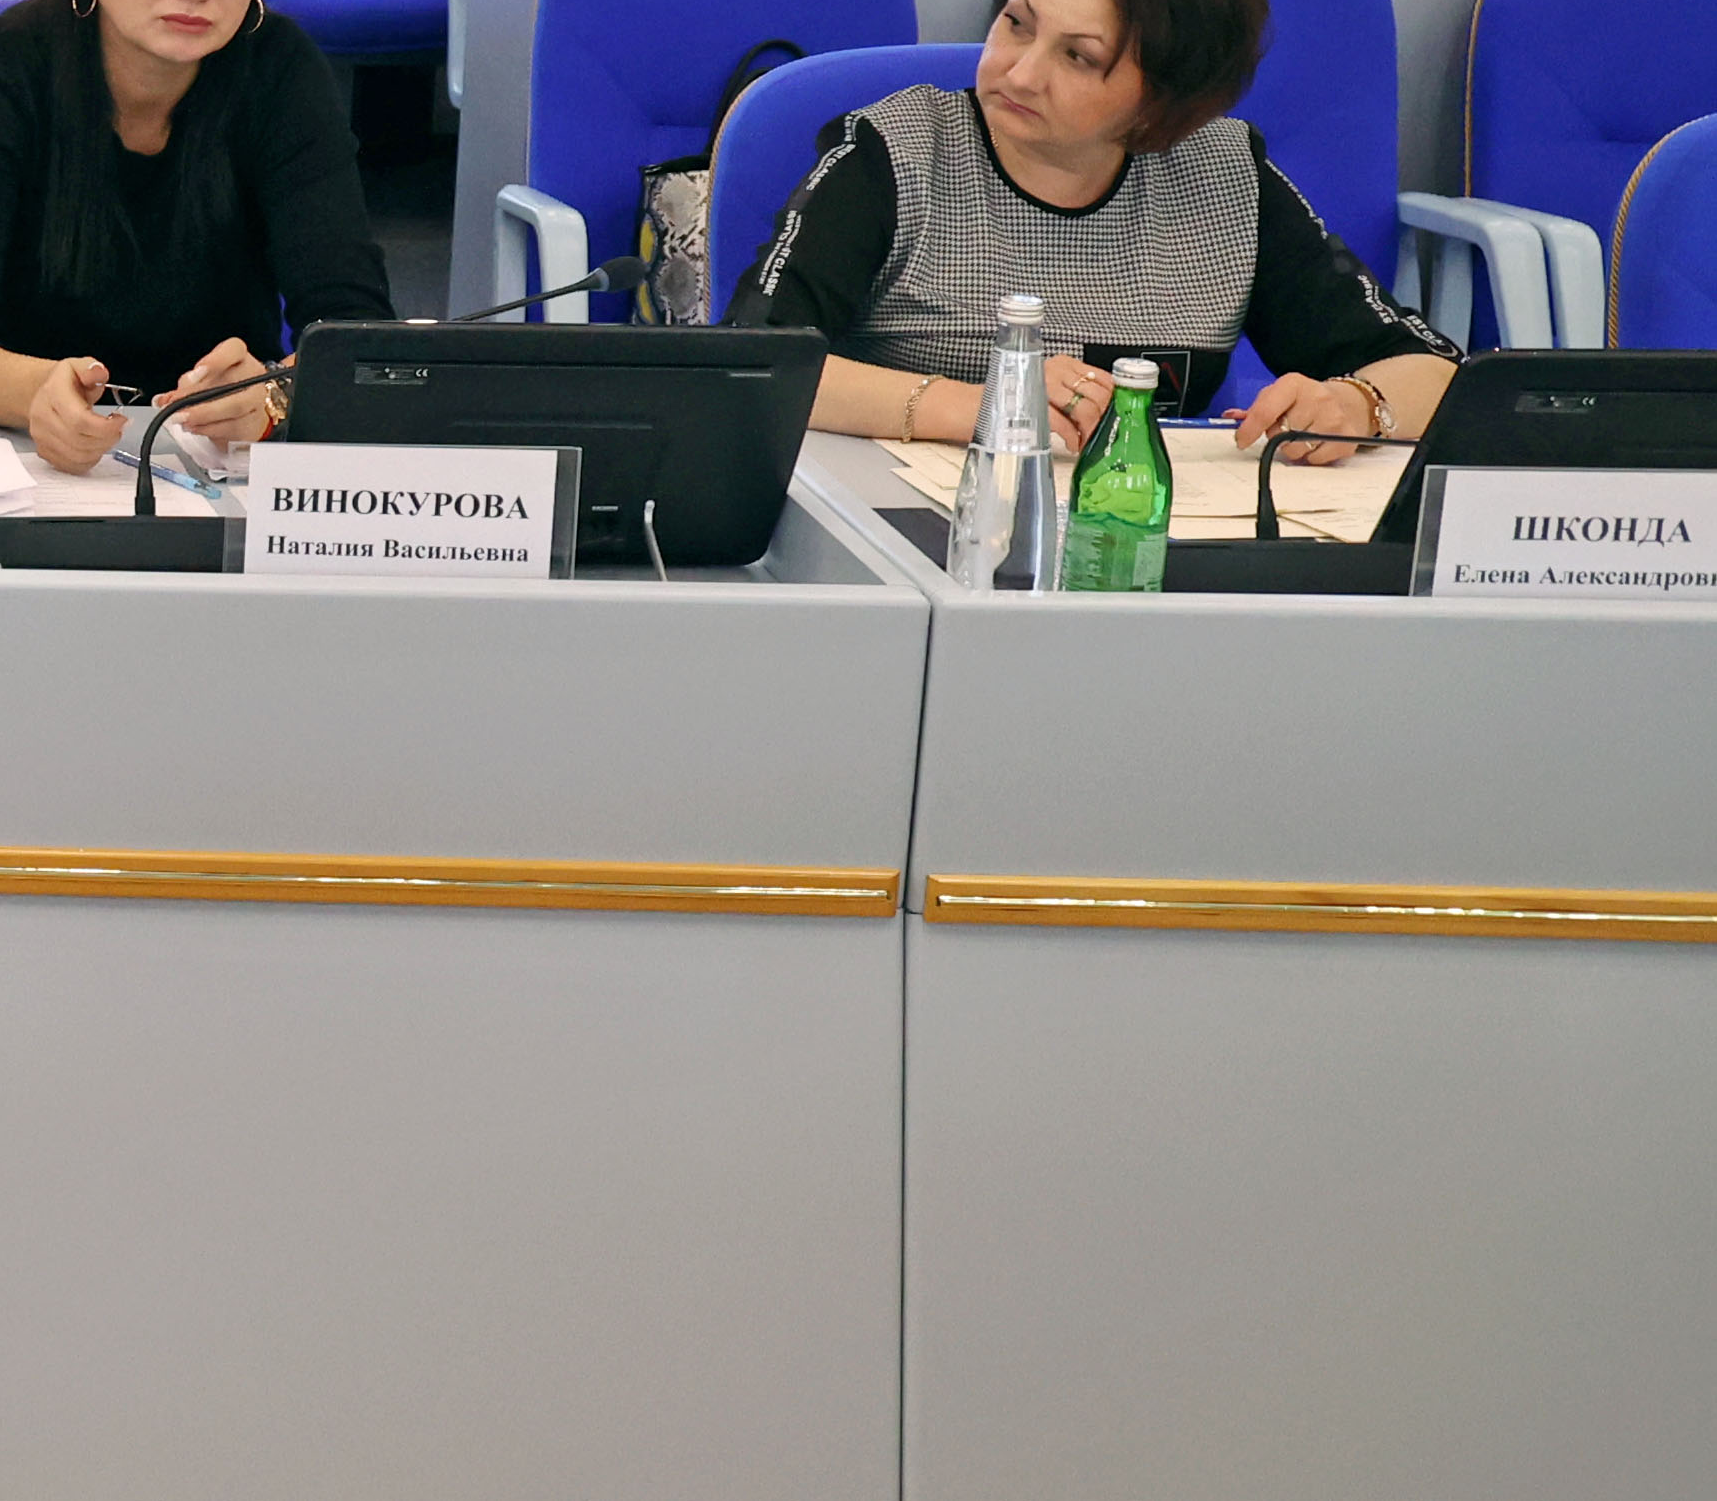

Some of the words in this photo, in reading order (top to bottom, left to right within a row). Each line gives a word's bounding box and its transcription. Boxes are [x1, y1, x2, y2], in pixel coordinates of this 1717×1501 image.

[273, 487, 530, 520] ВИНОКУРОВА
[1512, 516, 1692, 548] ШКОНДА
[267, 535, 374, 559] Наталия
[383, 539, 529, 564] Васильевна
[1454, 564, 1531, 585] Елена
